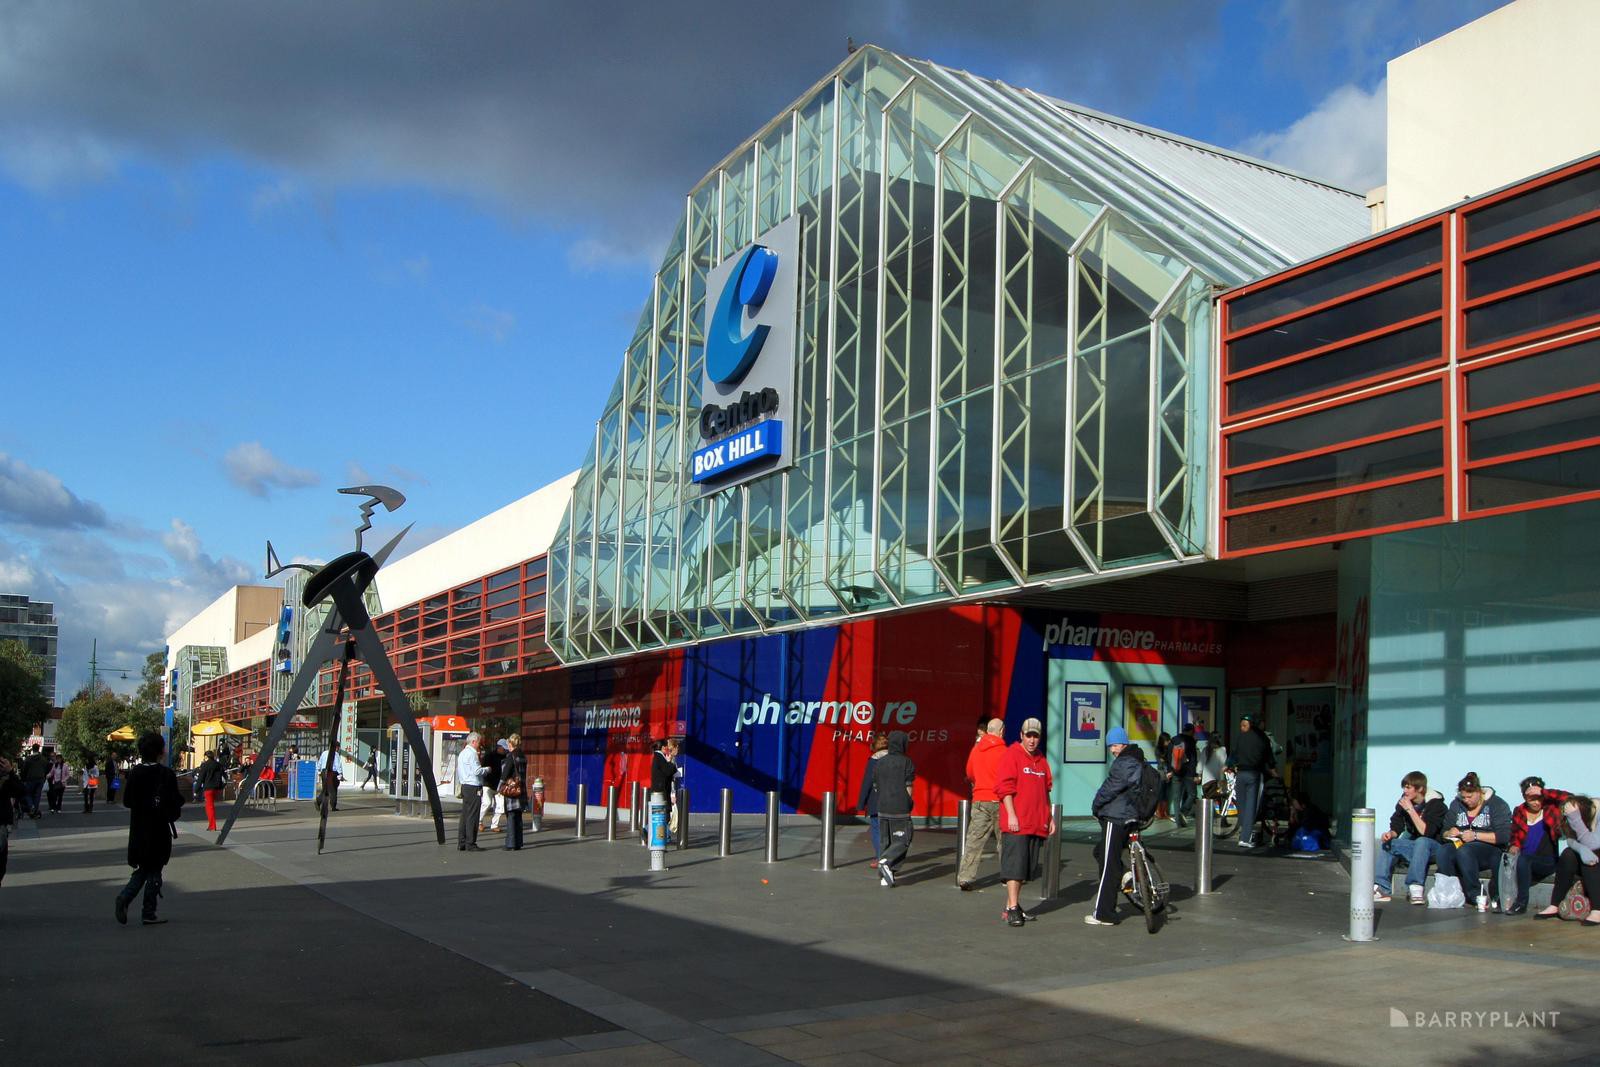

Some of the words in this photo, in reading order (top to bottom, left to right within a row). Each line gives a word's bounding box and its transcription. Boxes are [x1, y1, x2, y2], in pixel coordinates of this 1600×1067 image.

[699, 387, 779, 439] Centro
[695, 446, 724, 475] BOX
[729, 430, 764, 462] HILL
[1043, 617, 1155, 652] pharmore
[1155, 640, 1222, 654] PHARMACIES
[584, 704, 641, 736] pharmore
[832, 730, 949, 742] PHARCIES
